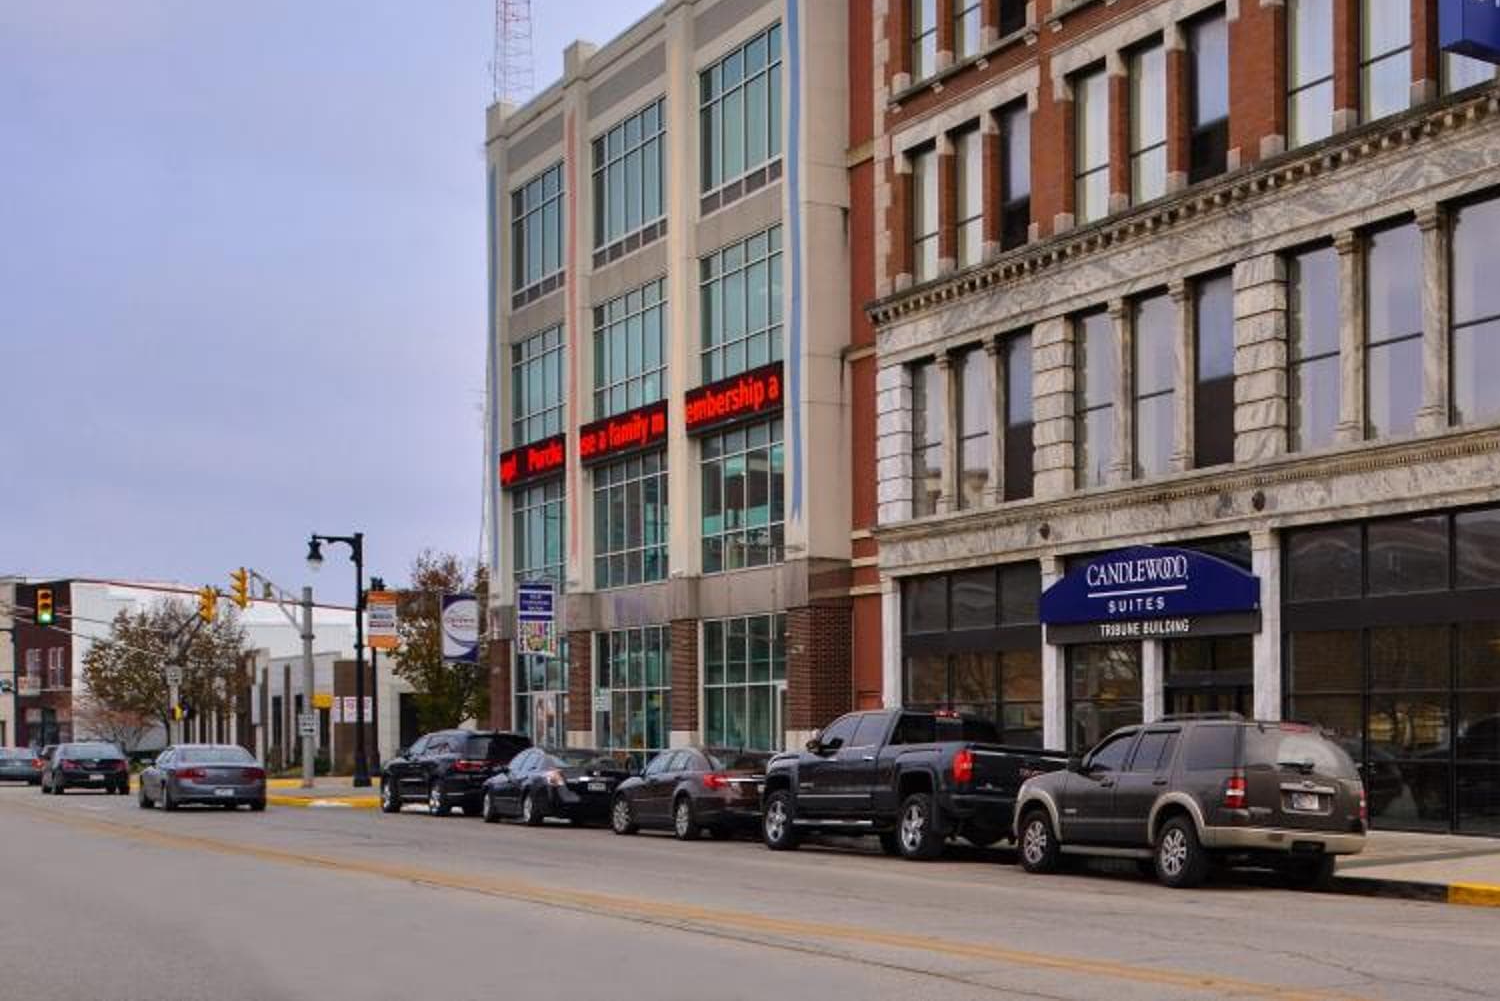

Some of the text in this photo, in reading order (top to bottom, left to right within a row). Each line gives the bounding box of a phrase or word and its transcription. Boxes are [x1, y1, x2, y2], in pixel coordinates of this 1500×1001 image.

[608, 413, 649, 449] family
[1086, 555, 1187, 586] CANDLEWOOD
[1108, 596, 1165, 614] SUITES
[1100, 618, 1190, 638] TRIBUNE BUILDING
